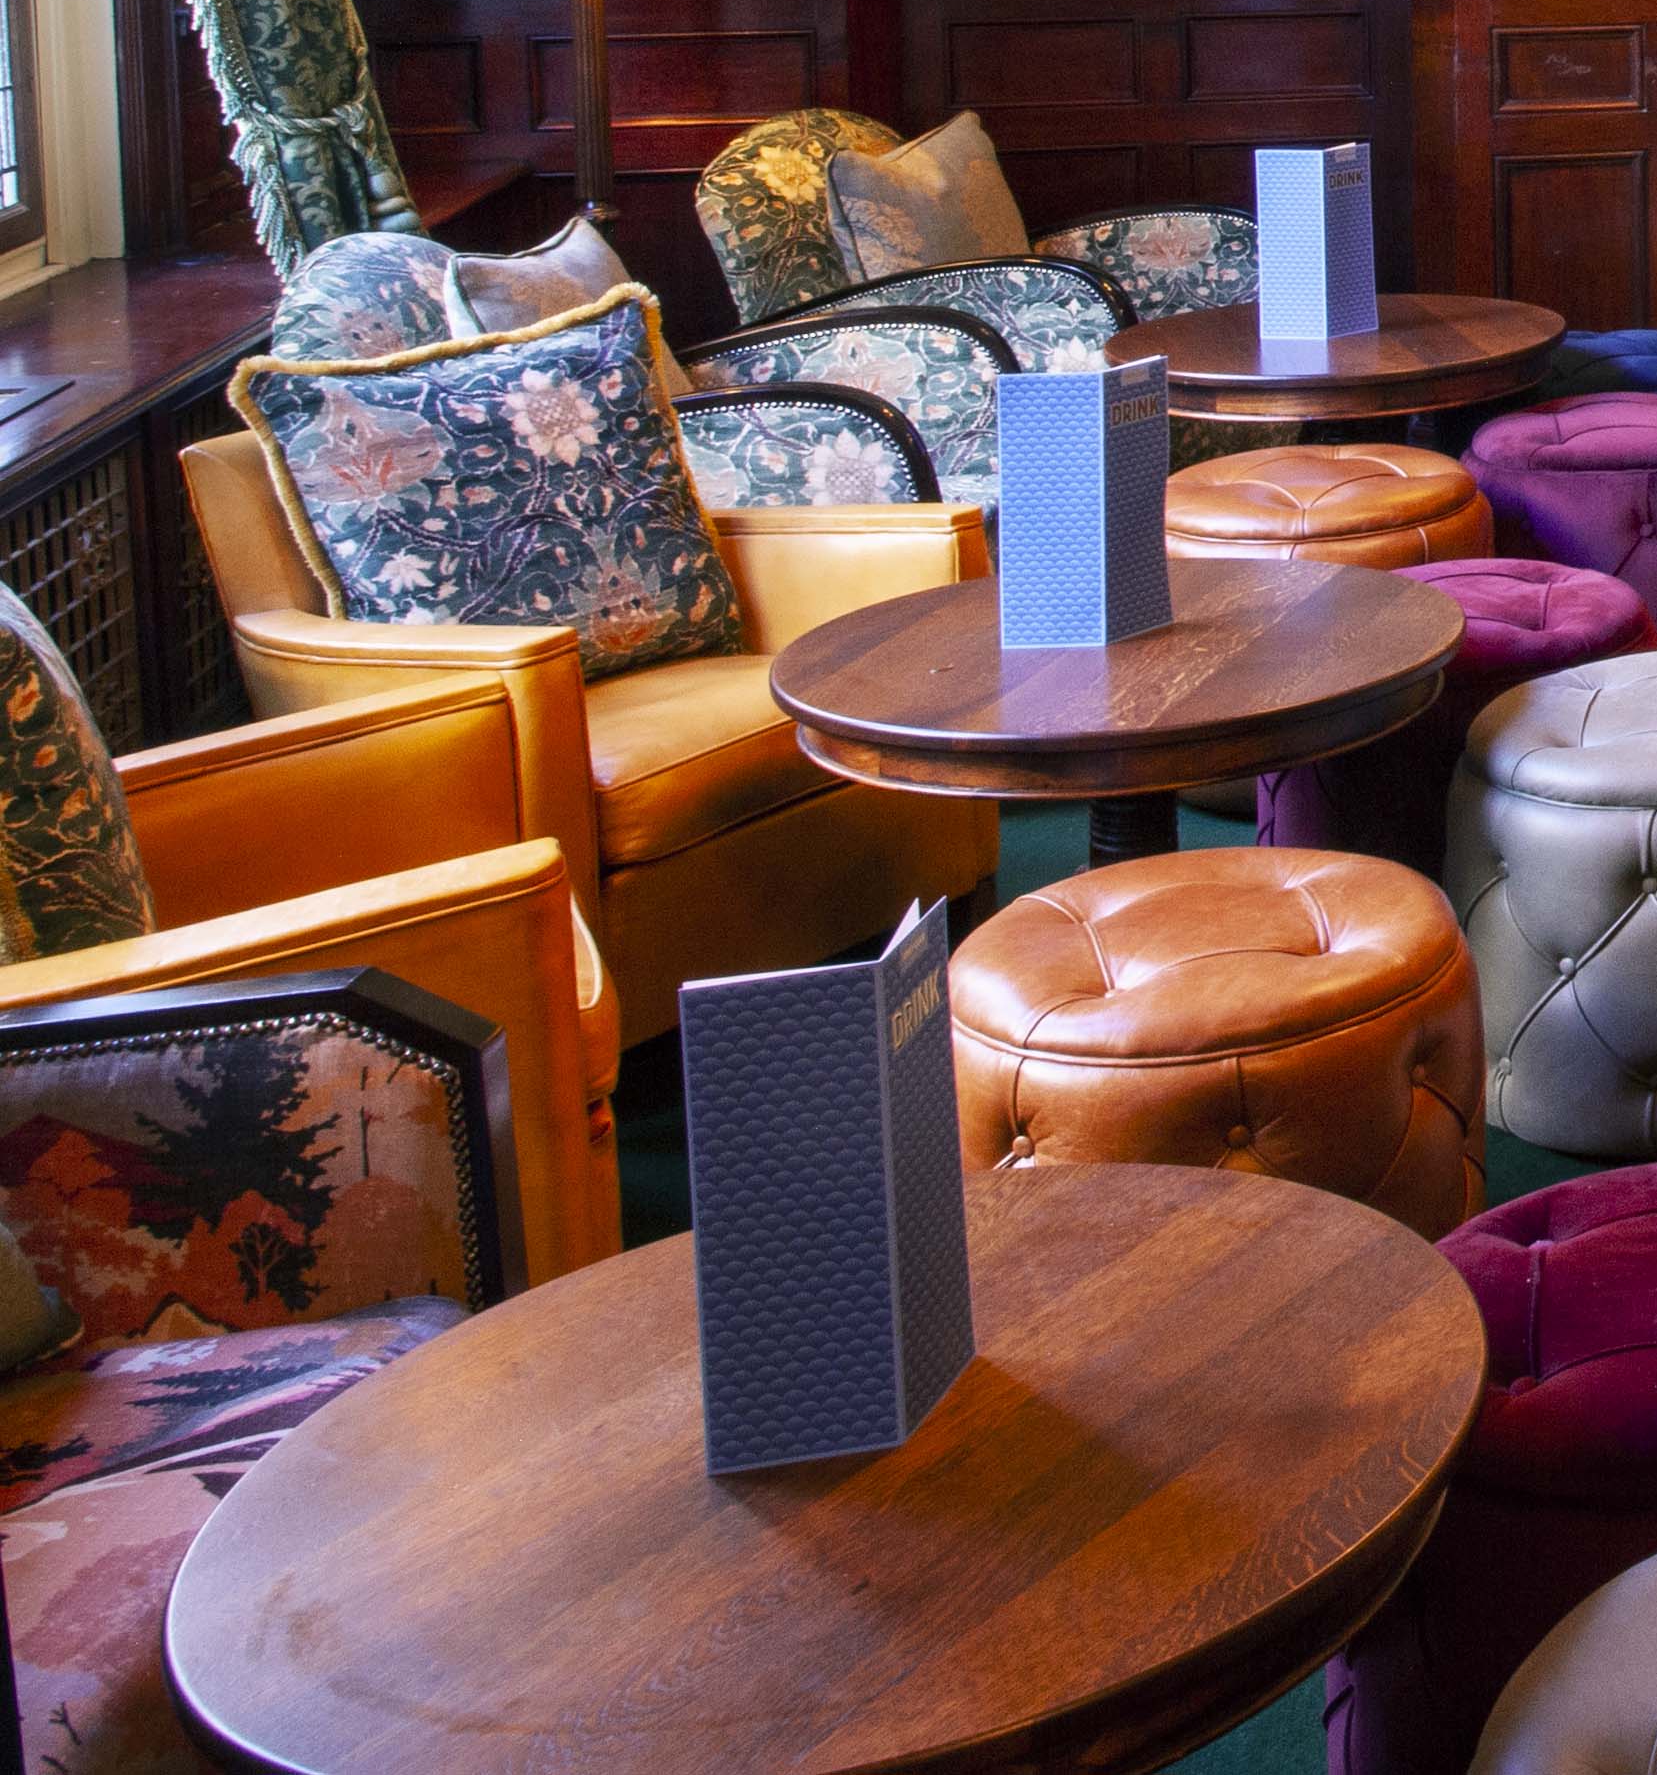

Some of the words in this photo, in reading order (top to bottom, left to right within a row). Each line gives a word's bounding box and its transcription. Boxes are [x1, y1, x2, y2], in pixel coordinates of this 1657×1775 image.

[1328, 168, 1365, 189] DRINK
[1110, 393, 1161, 428] DRINK
[890, 967, 942, 1052] DRINK
